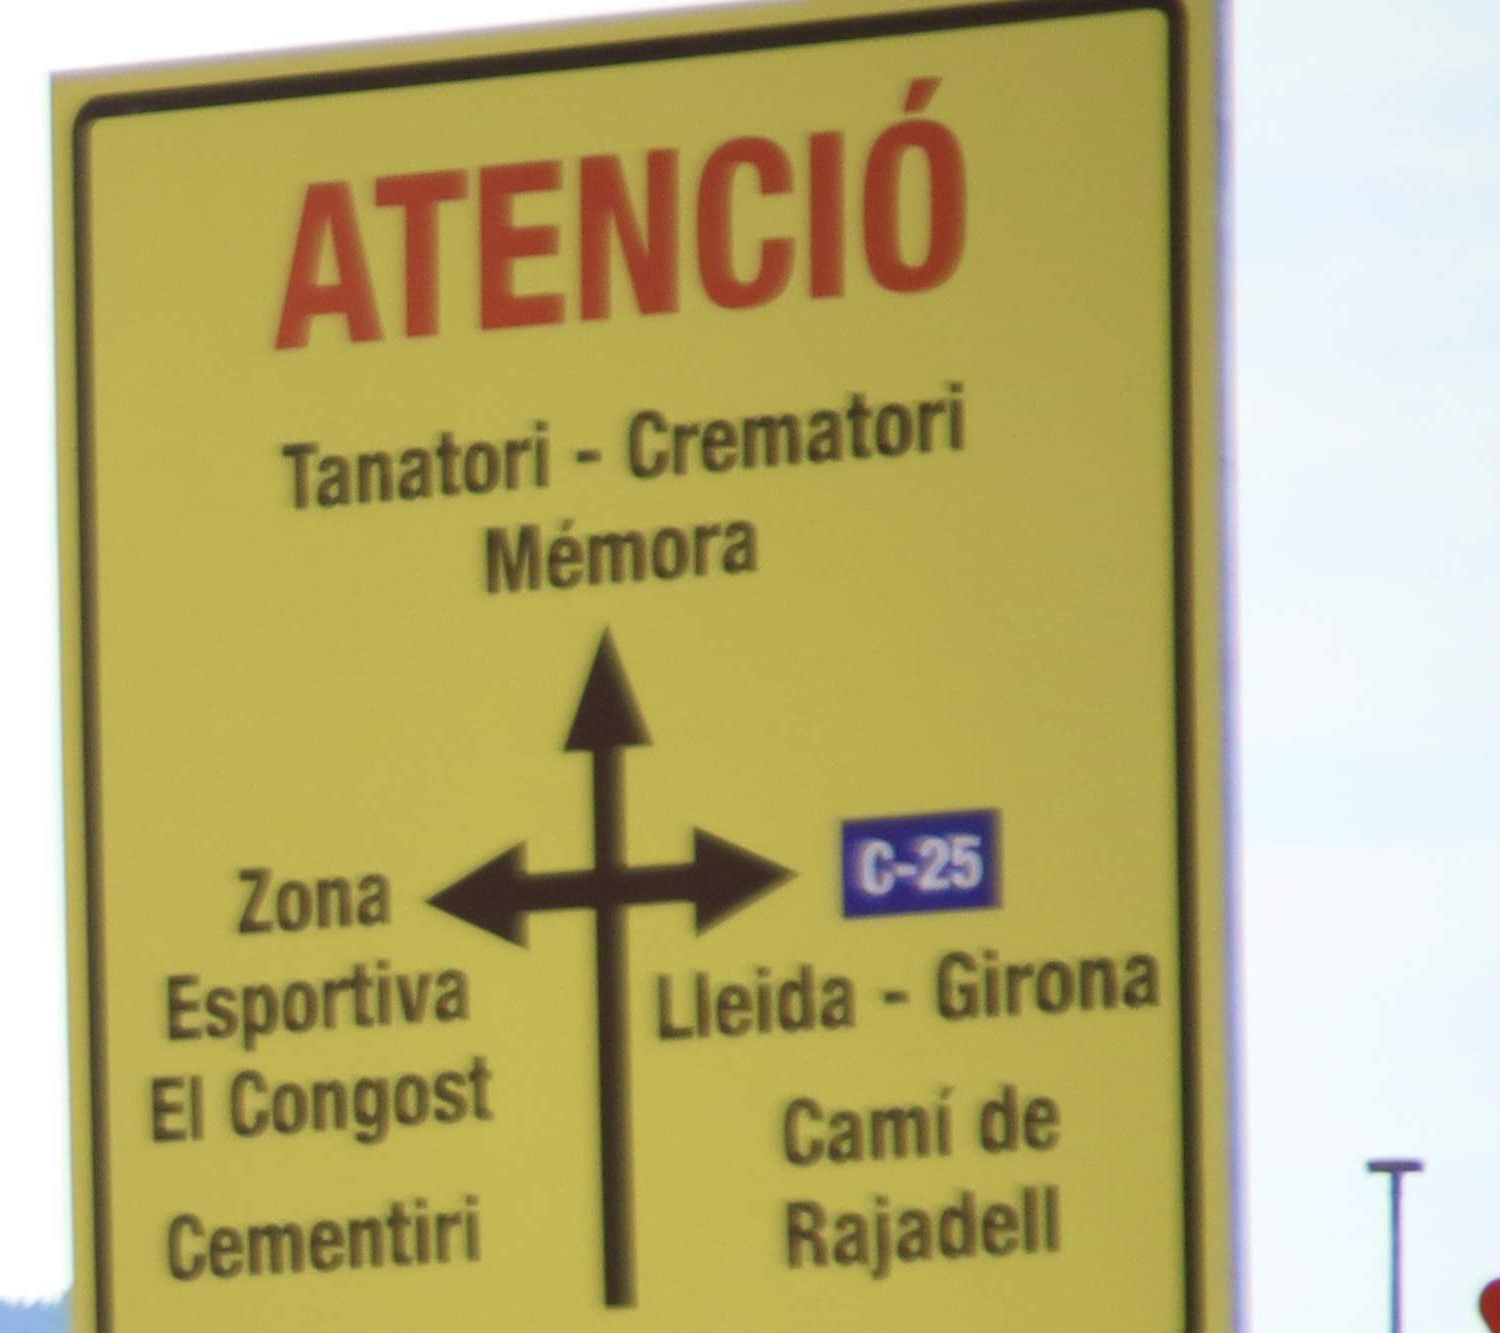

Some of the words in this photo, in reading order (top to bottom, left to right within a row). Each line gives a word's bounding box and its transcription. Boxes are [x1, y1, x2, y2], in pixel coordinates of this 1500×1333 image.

[272, 76, 967, 351] ATENCIÓ
[281, 420, 550, 511] Tanatori
[627, 382, 965, 480] Crematori
[484, 519, 758, 594] Mémora
[236, 868, 392, 935] Zona
[859, 835, 983, 895] C-25
[165, 959, 468, 1052] Esportiva
[656, 964, 856, 1041] Lleida
[935, 950, 1161, 1021] Girona
[149, 1077, 205, 1143] El
[229, 1056, 493, 1146] Congost
[782, 1088, 952, 1167] Camí
[979, 1086, 1061, 1152] de
[167, 1194, 480, 1281] Cementiri
[785, 1185, 1060, 1279] Rajadell
